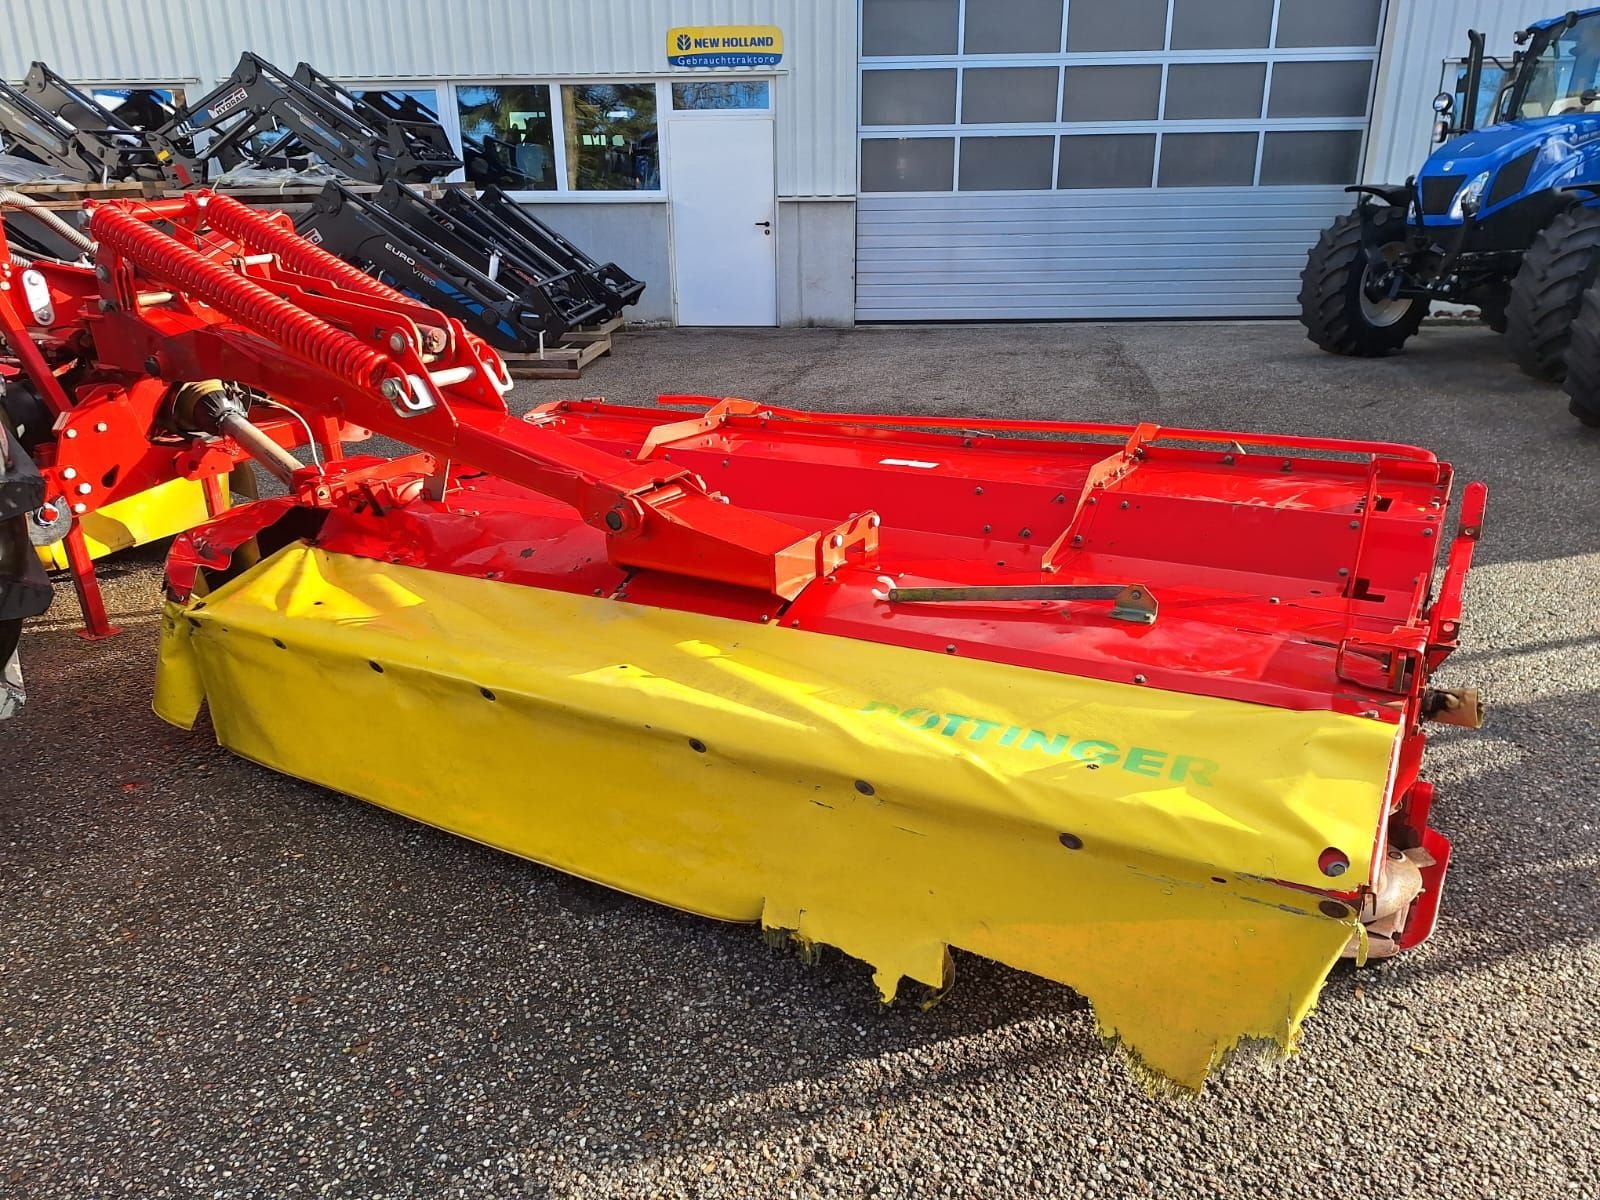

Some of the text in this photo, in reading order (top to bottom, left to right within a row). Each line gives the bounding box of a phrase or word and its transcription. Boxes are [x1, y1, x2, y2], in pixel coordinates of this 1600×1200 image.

[694, 36, 774, 49] NEW HOLLAND
[677, 56, 776, 66] Gebrauchttraktore
[215, 93, 246, 115] HYDRAC
[385, 242, 416, 266] EURO
